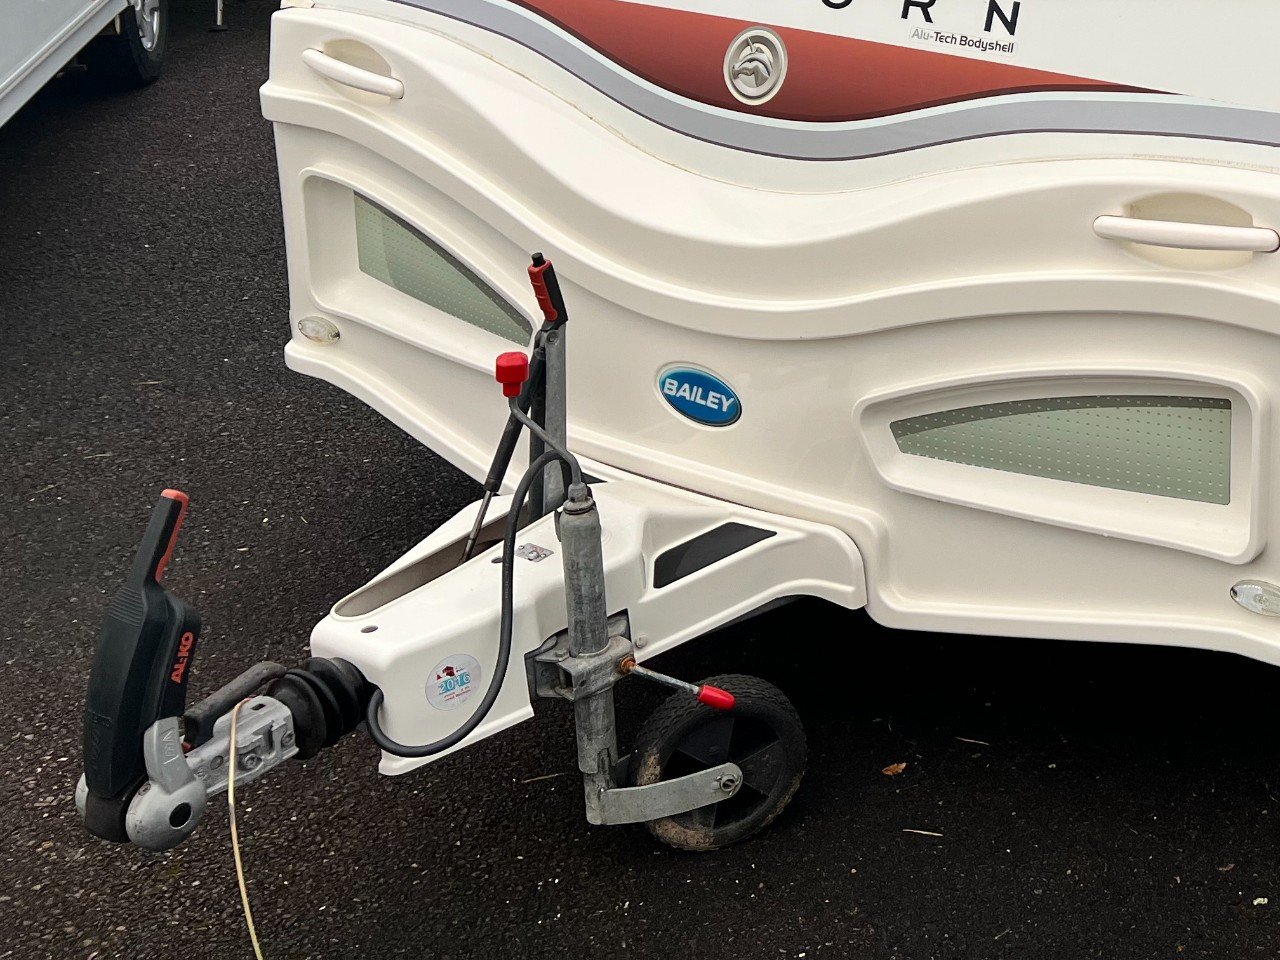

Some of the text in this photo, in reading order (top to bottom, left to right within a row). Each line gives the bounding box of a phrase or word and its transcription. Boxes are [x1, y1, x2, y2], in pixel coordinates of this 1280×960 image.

[911, 28, 1014, 53] Alu-Tech Bodyshell
[663, 378, 735, 413] BAILEY
[171, 631, 195, 684] AL-KO
[439, 672, 471, 695] 2016
